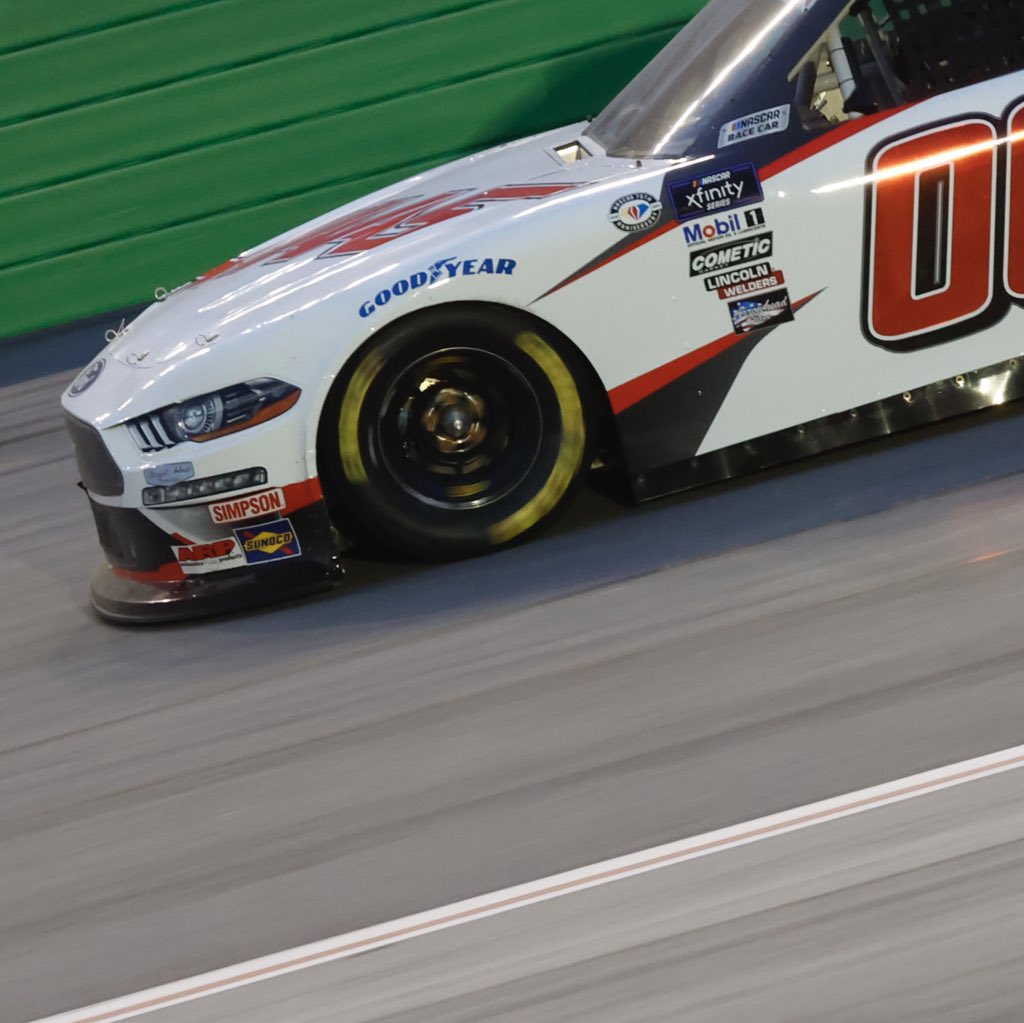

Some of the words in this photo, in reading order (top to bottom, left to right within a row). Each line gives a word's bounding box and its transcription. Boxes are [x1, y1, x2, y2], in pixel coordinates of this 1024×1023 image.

[727, 126, 755, 142] RACE
[757, 121, 779, 135] CAR
[740, 109, 780, 131] NASCAR
[702, 171, 731, 186] NASCAR
[685, 180, 744, 209] xfinity
[706, 197, 731, 211] SERIES
[683, 214, 741, 243] Mobil
[747, 209, 761, 227] 1
[691, 238, 771, 271] COMETIC
[358, 256, 517, 318] GOODYEAR
[707, 264, 769, 289] LINCOLN
[723, 276, 778, 297] WELDERS
[212, 491, 281, 522] SIMPSON
[246, 533, 291, 551] SUNOCO
